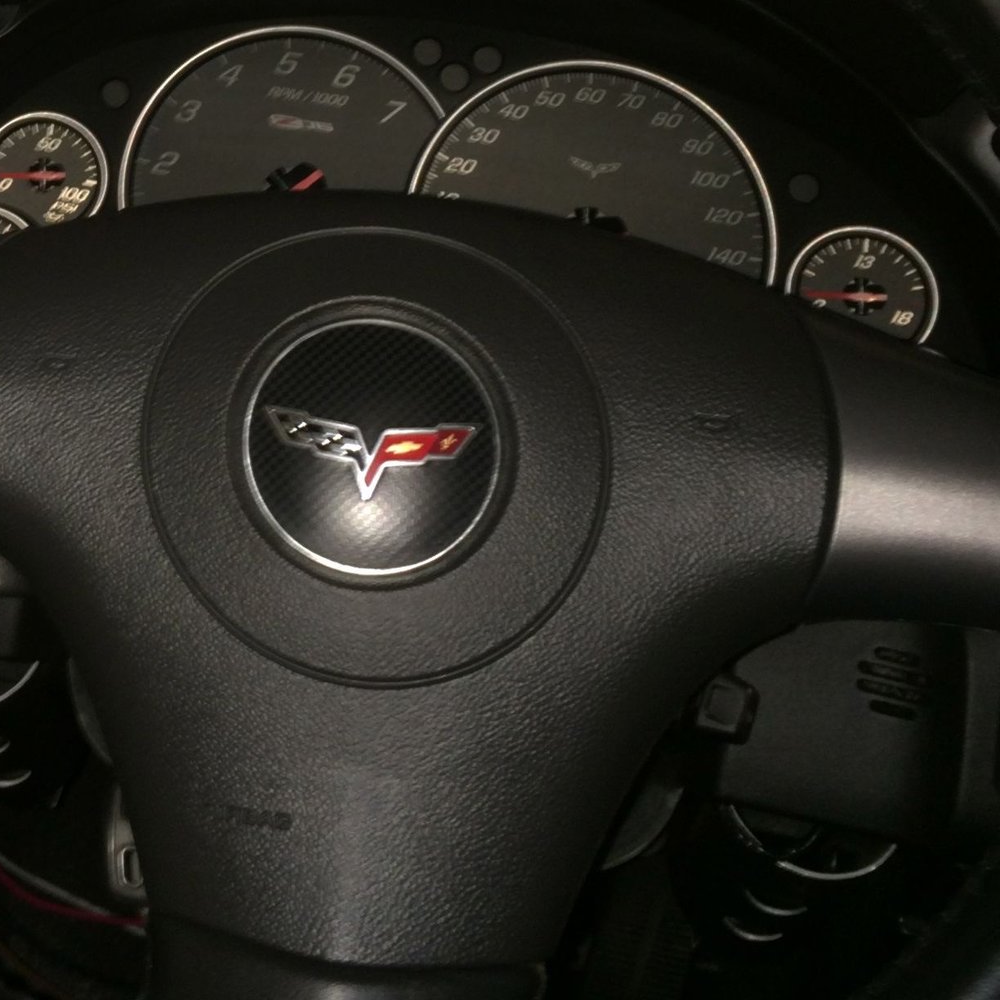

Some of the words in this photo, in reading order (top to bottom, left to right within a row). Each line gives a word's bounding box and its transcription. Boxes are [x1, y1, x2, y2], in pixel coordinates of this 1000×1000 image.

[274, 51, 303, 75] 5
[218, 64, 244, 87] 4
[331, 64, 360, 88] 6
[534, 91, 566, 108] 50
[575, 86, 607, 103] 60
[616, 93, 646, 110] 70
[174, 100, 201, 123] 3
[379, 101, 407, 124] 7
[500, 104, 530, 120] 40
[650, 111, 683, 129] 80
[467, 127, 500, 144] 30
[681, 138, 714, 156] 90
[151, 151, 180, 176] 2
[444, 157, 478, 175] 20
[690, 171, 731, 189] 100
[57, 186, 90, 203] 100
[704, 207, 743, 225] 120
[705, 247, 748, 266] 140
[853, 254, 876, 269] 13
[890, 310, 914, 326] 18
